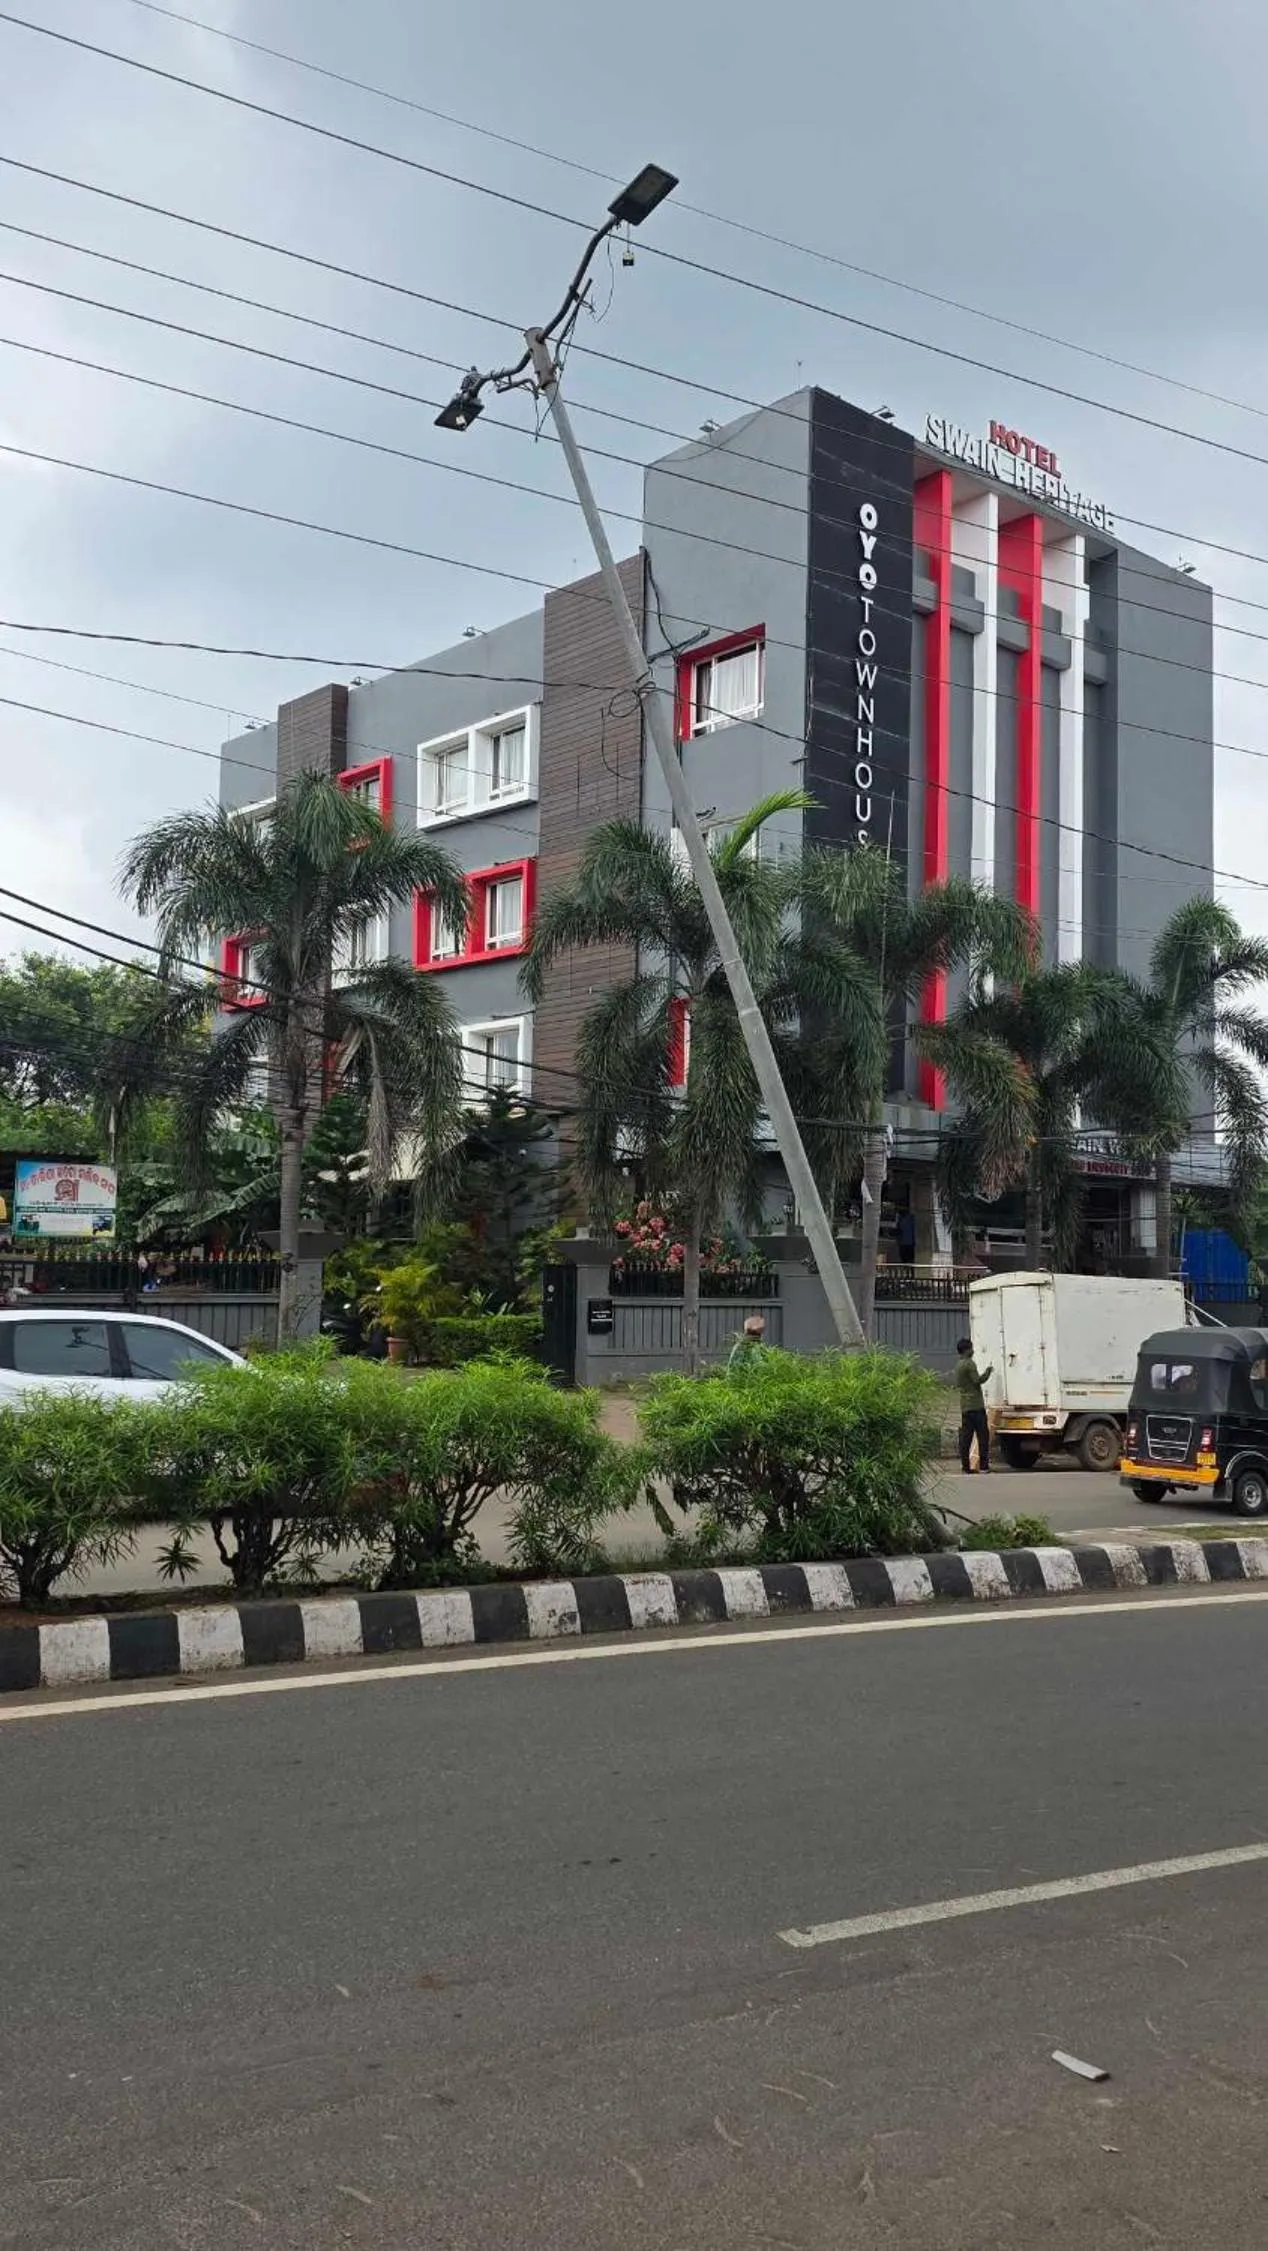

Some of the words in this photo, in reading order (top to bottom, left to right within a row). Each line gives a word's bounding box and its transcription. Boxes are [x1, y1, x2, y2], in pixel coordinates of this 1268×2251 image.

[926, 411, 1000, 480] SWAIN
[1013, 456, 1115, 536] HERITAGE
[989, 420, 1062, 479] HOTEL
[859, 502, 878, 591] OYO
[854, 595, 878, 846] TOWNHOUS
